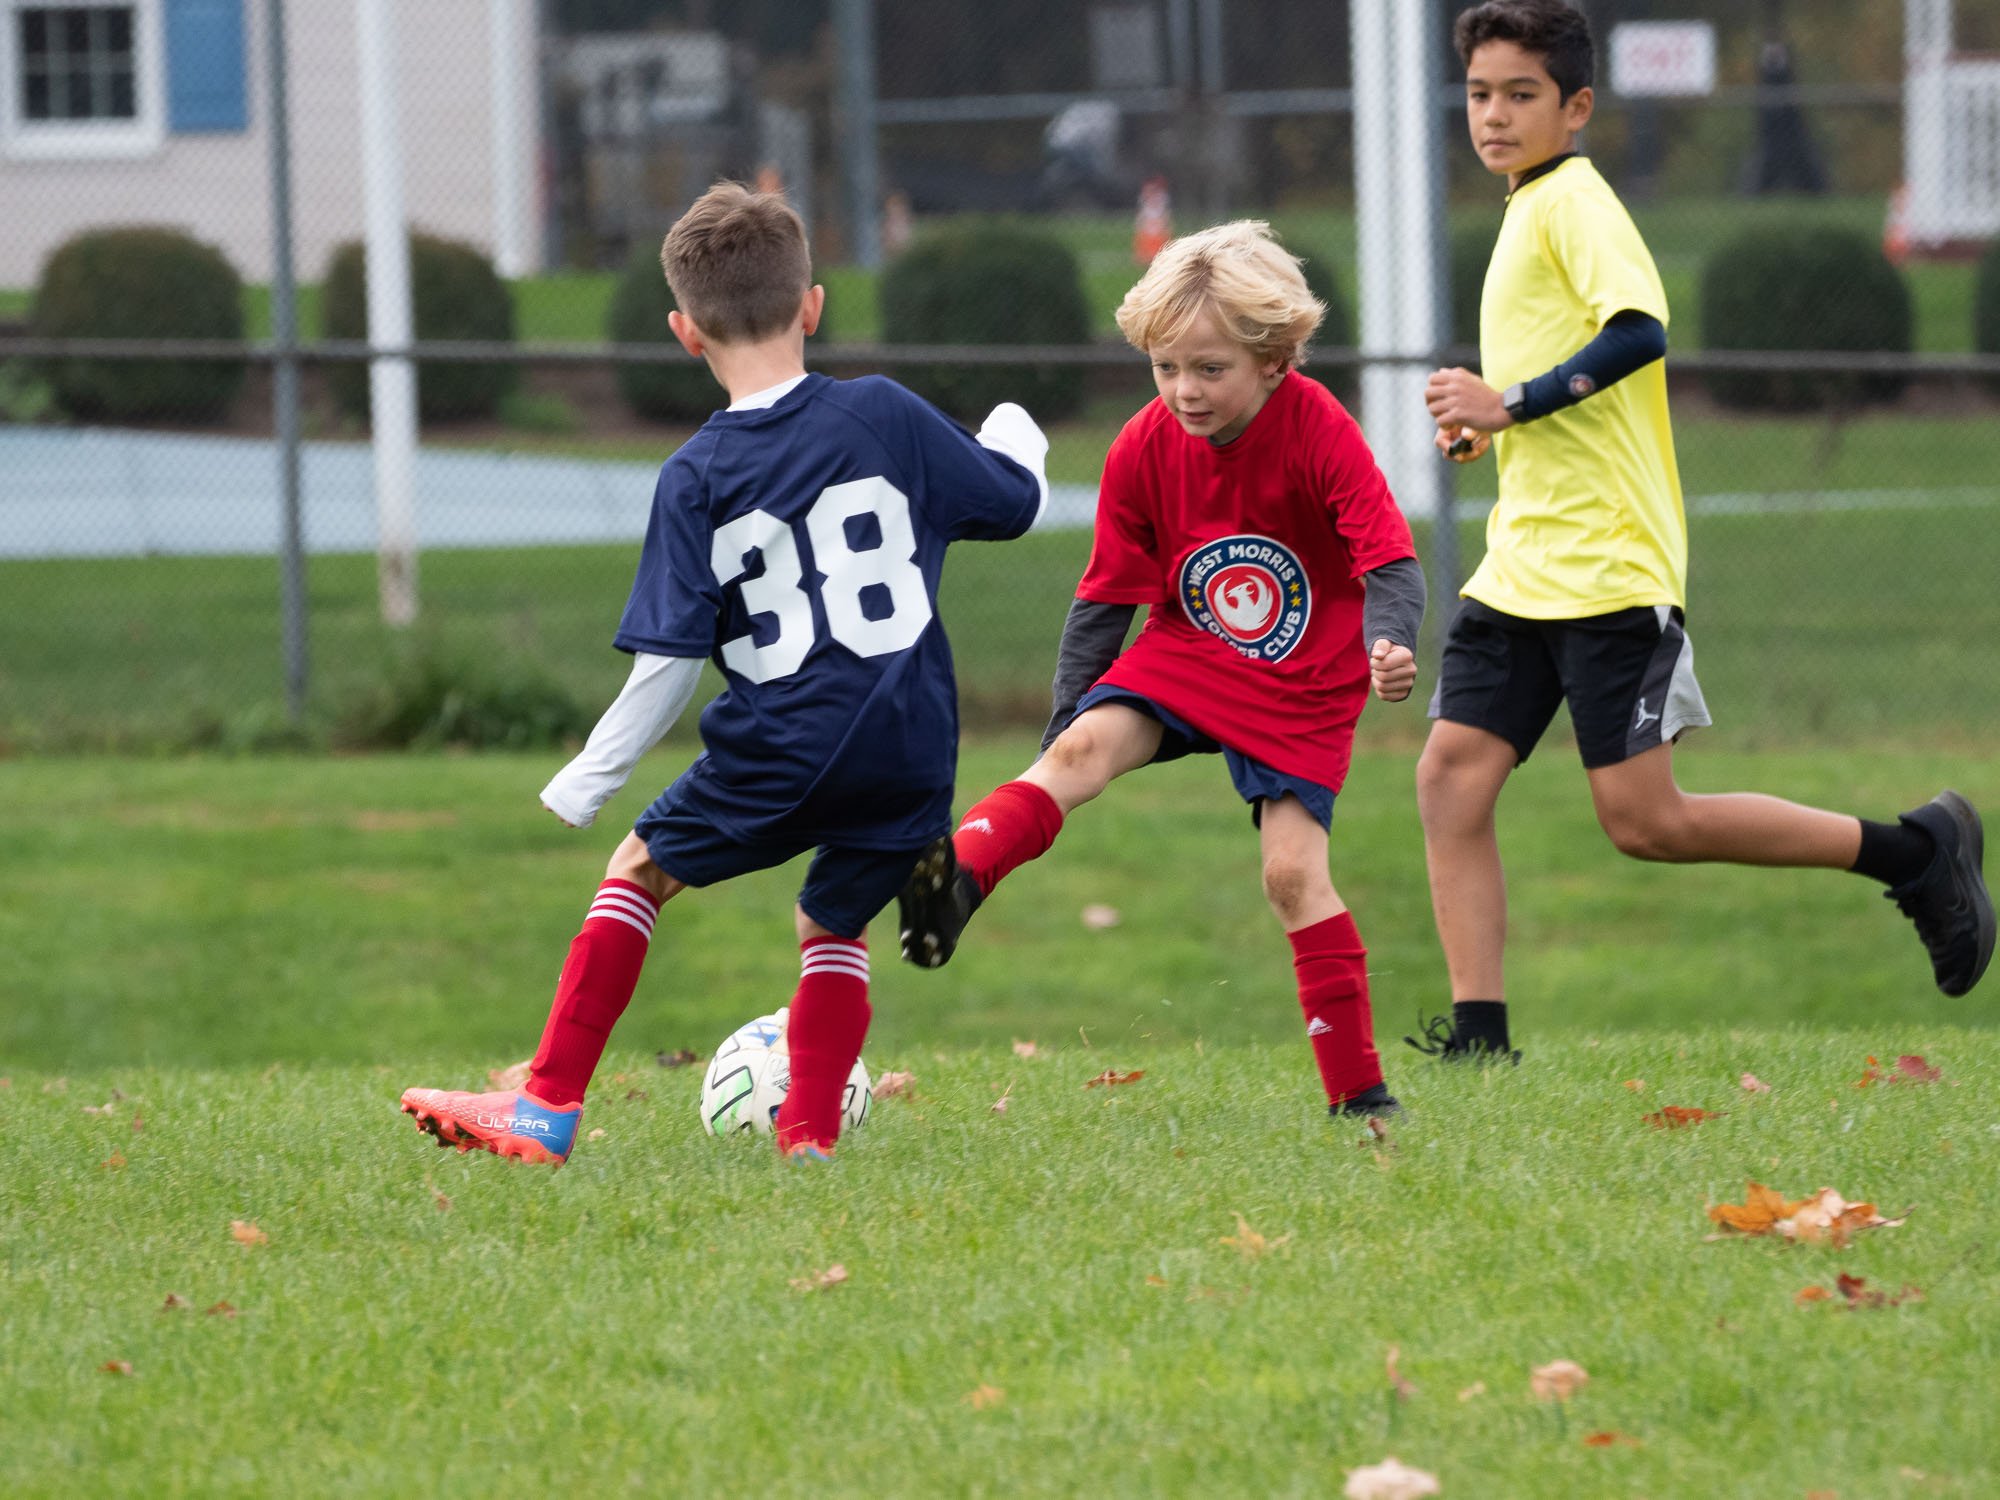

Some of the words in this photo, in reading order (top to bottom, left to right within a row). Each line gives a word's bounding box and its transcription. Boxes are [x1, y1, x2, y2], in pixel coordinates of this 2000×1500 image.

[710, 475, 933, 685] 38
[1188, 549, 1222, 586] WEST
[1229, 544, 1296, 581] MORRIS
[1264, 611, 1301, 656] CLUB
[478, 1115, 549, 1131] ULTRA
